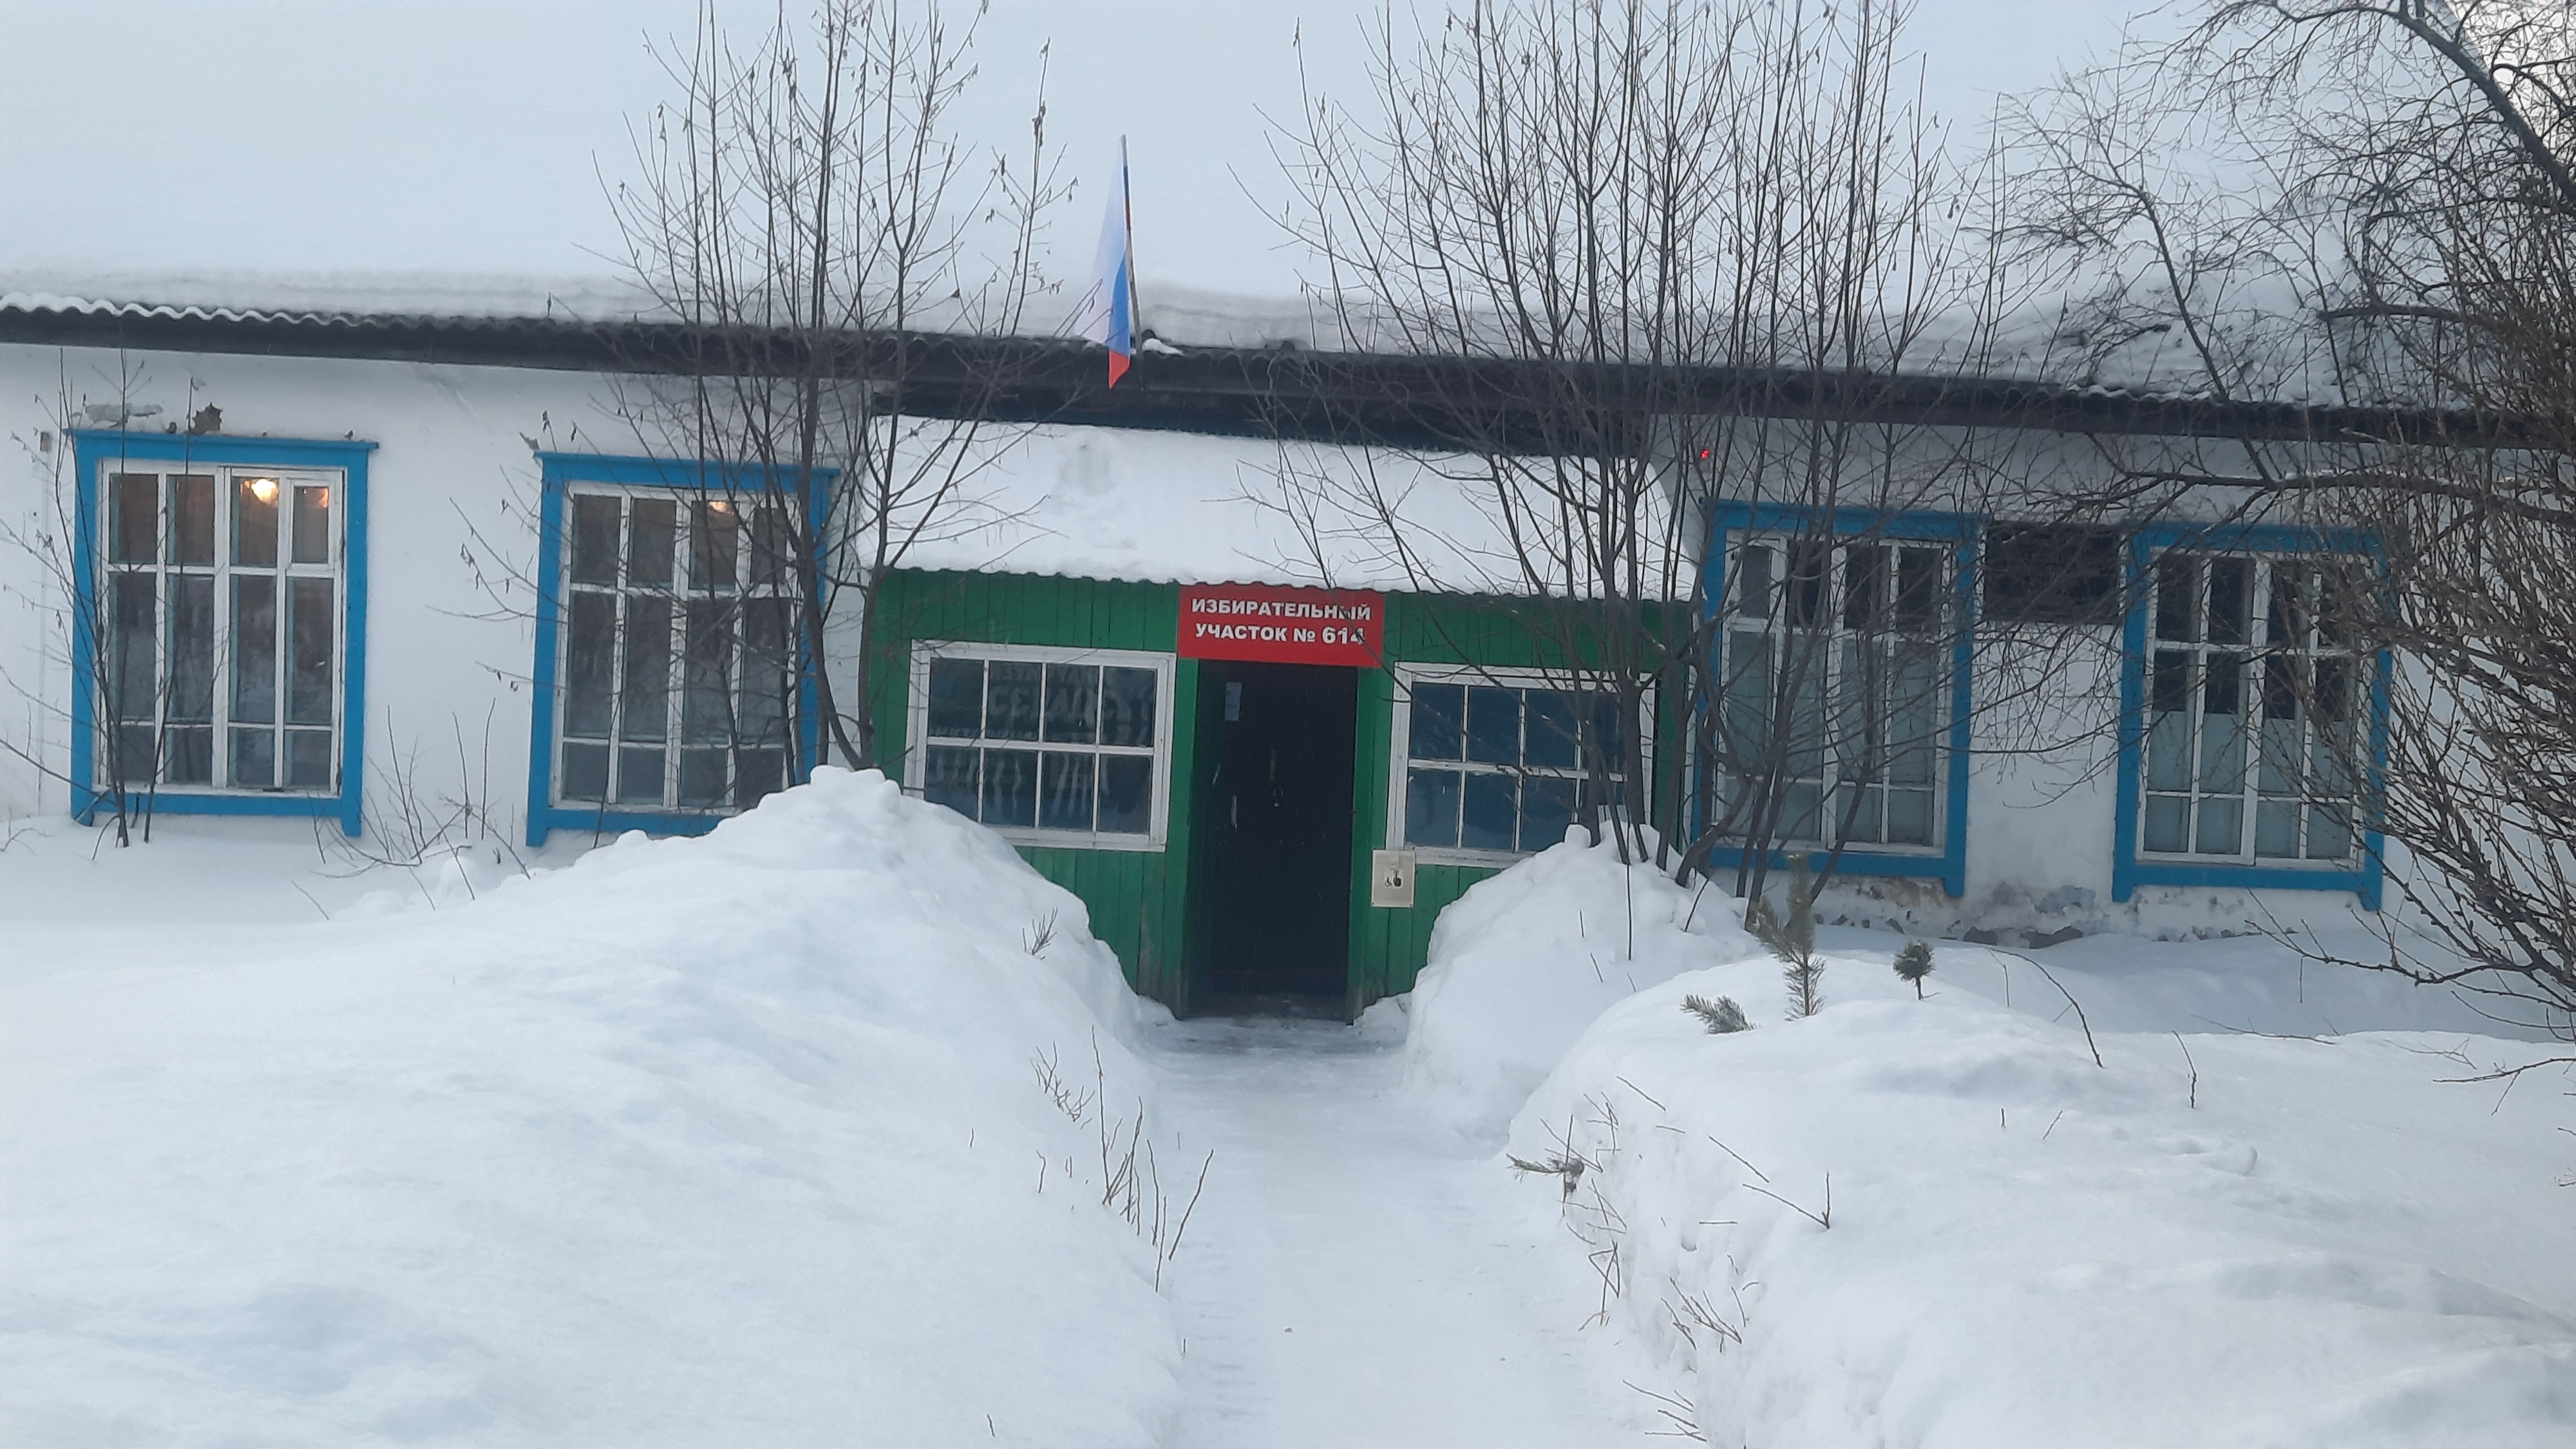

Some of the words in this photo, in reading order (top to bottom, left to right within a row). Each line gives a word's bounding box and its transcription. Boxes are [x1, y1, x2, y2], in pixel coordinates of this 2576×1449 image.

[1191, 598, 1371, 621] ИЗБИРАТЕЛЬНЫЙ
[1195, 622, 1287, 641] УЧАСТОК
[1293, 628, 1316, 643] №
